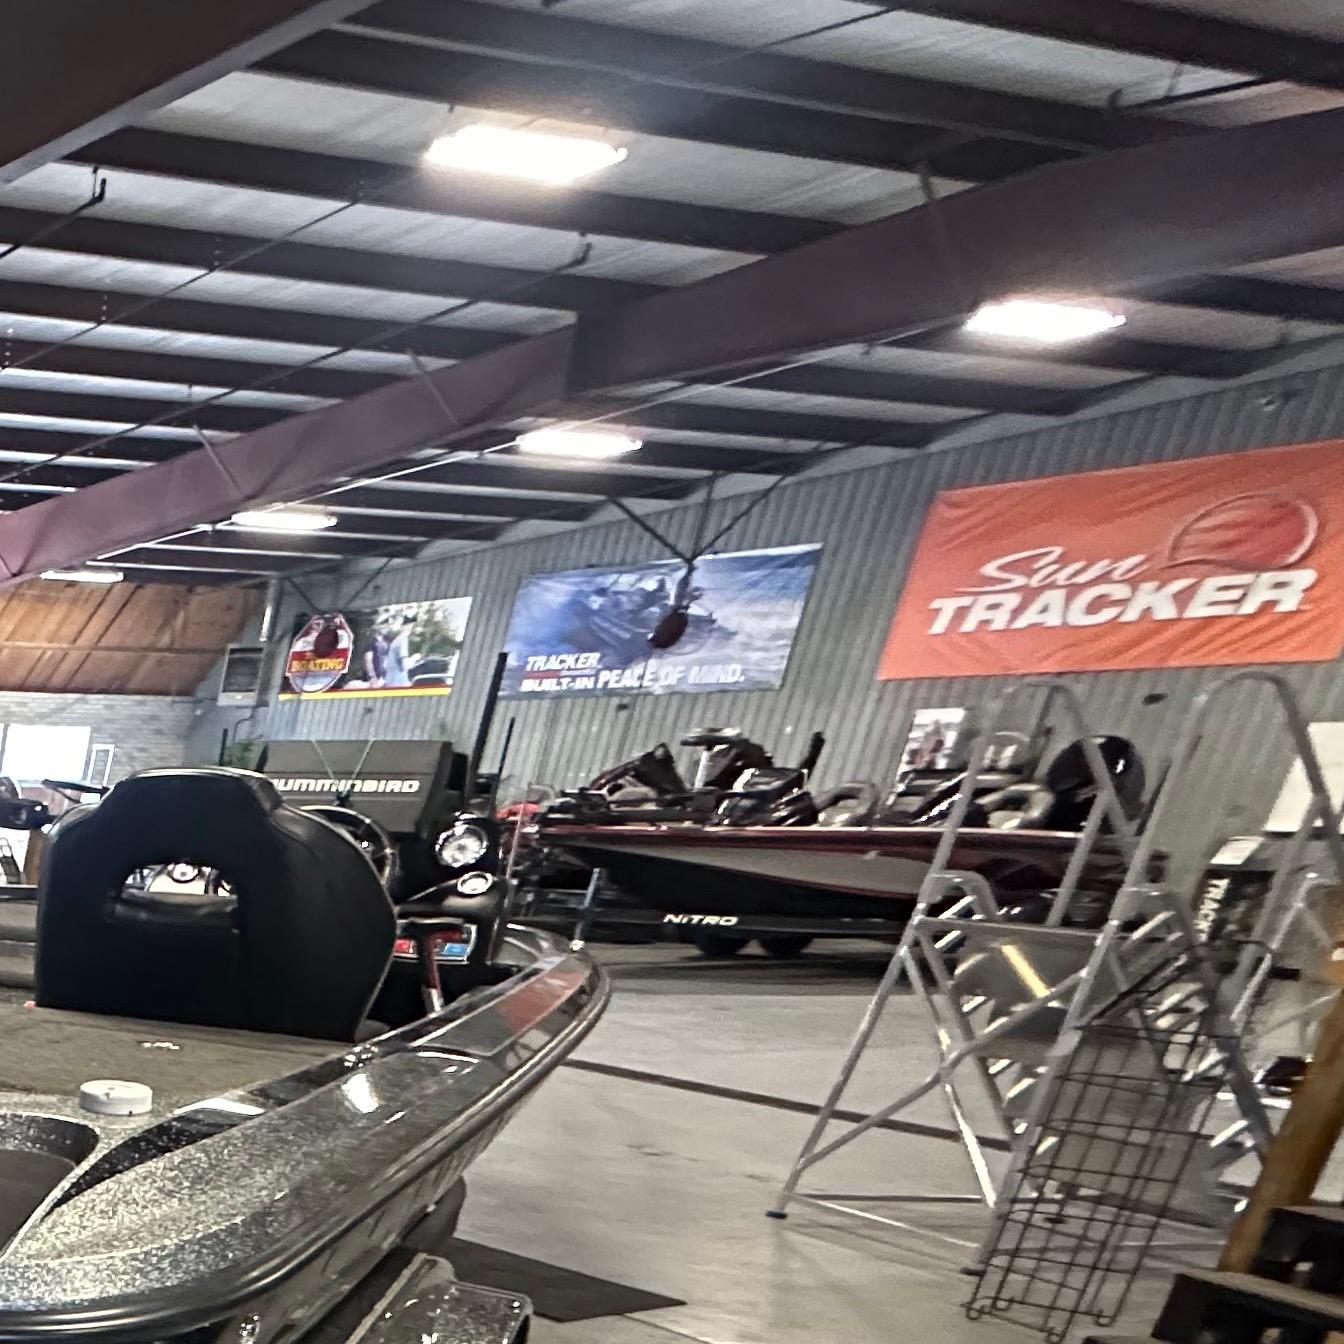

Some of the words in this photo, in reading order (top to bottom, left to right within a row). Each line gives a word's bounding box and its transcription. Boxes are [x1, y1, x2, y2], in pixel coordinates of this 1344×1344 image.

[958, 545, 1153, 593] Sun
[928, 567, 1319, 636] TRACKER
[527, 652, 601, 671] TRACKER
[520, 676, 595, 692] BUILT-IN
[597, 663, 653, 689] PEACE
[663, 914, 739, 926] NITRO
